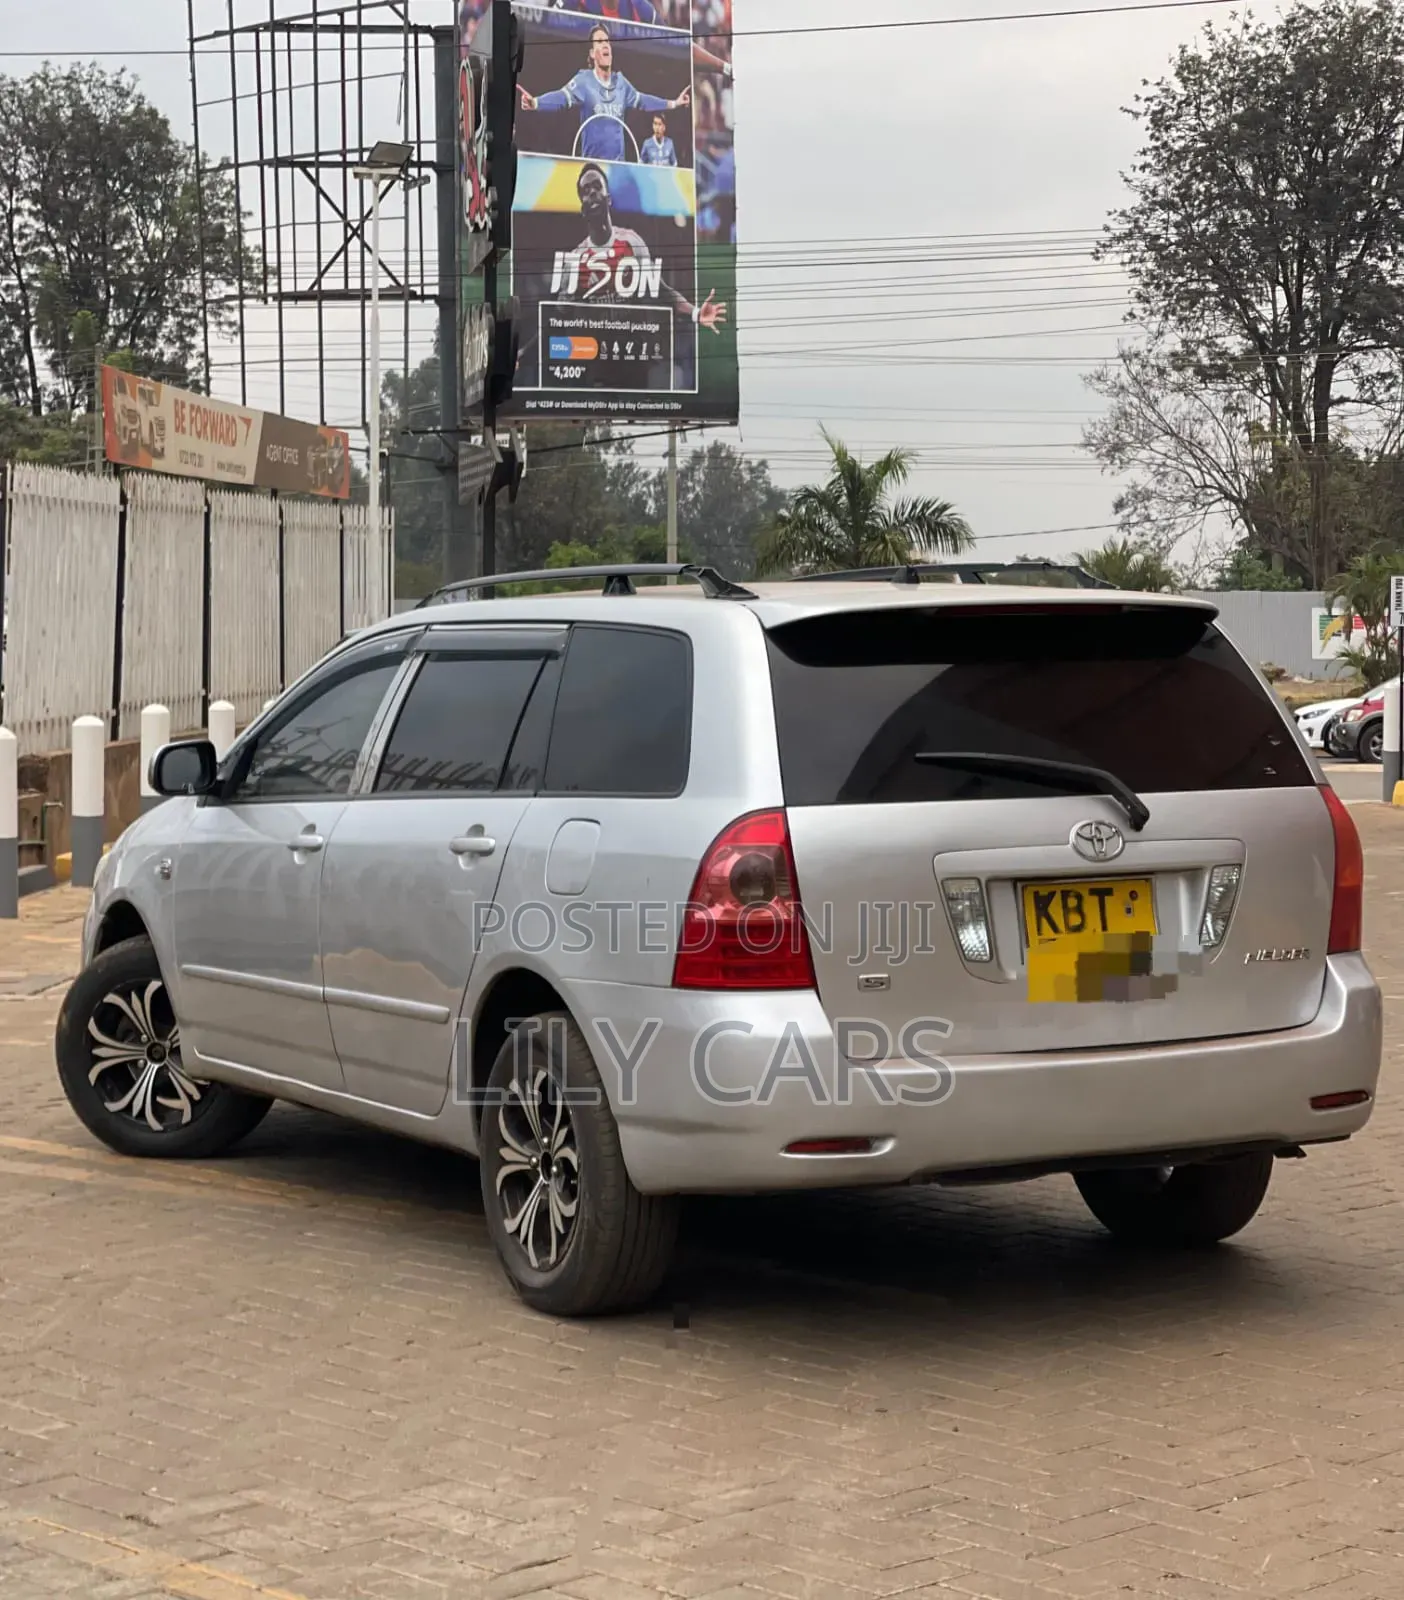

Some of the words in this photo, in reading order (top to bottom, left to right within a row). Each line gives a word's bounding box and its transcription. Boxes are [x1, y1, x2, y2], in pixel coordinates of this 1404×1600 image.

[550, 251, 612, 299] IT'S
[615, 256, 663, 298] ON
[549, 318, 562, 327] The
[563, 319, 588, 328] world's
[589, 319, 604, 329] best
[604, 320, 631, 331] football
[631, 322, 660, 333] package
[174, 398, 186, 435] BE
[189, 403, 238, 448] FORWARD
[608, 401, 618, 411] App
[1033, 888, 1114, 936] KBT
